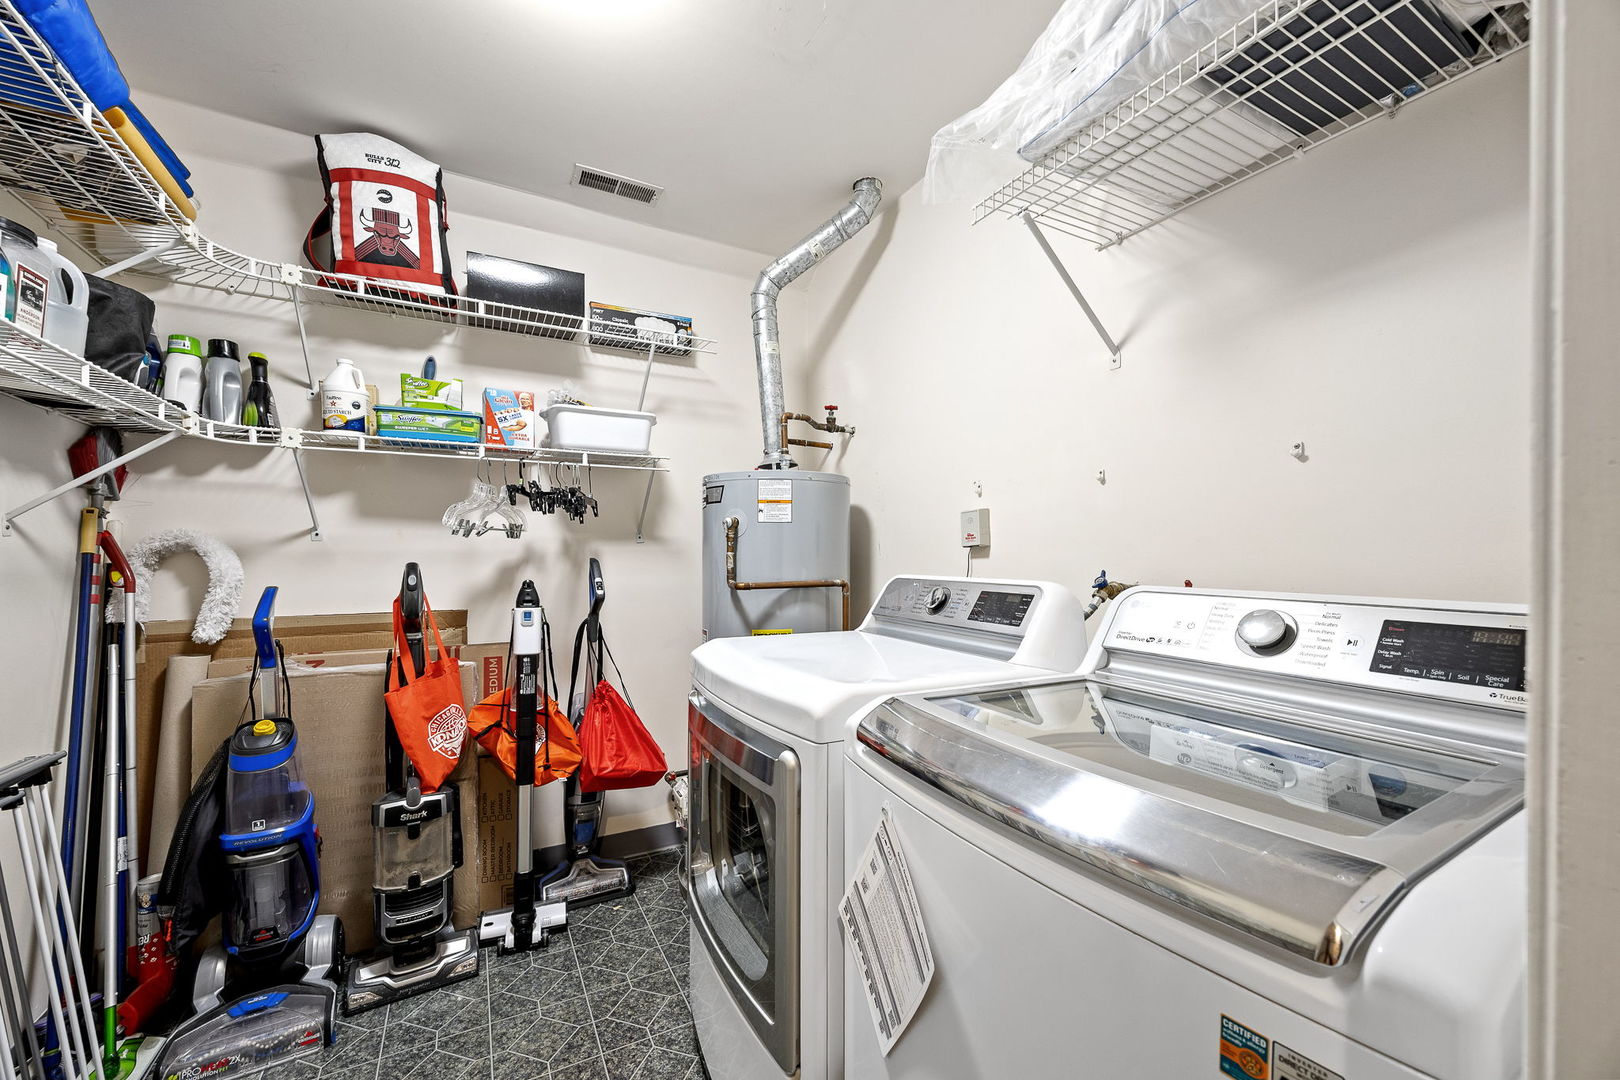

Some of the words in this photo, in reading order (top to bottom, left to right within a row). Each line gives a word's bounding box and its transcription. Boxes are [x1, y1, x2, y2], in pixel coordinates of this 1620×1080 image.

[367, 157, 382, 165] CITY
[396, 414, 423, 424] Swiffer
[489, 658, 498, 694] EDIUM
[1485, 675, 1510, 684] Special
[400, 810, 428, 821] Shark
[233, 834, 282, 846] REVOLUTION
[1222, 1018, 1267, 1049] CERTIFIED
[229, 1053, 241, 1066] 2X
[1278, 1054, 1308, 1076] DIRECT
